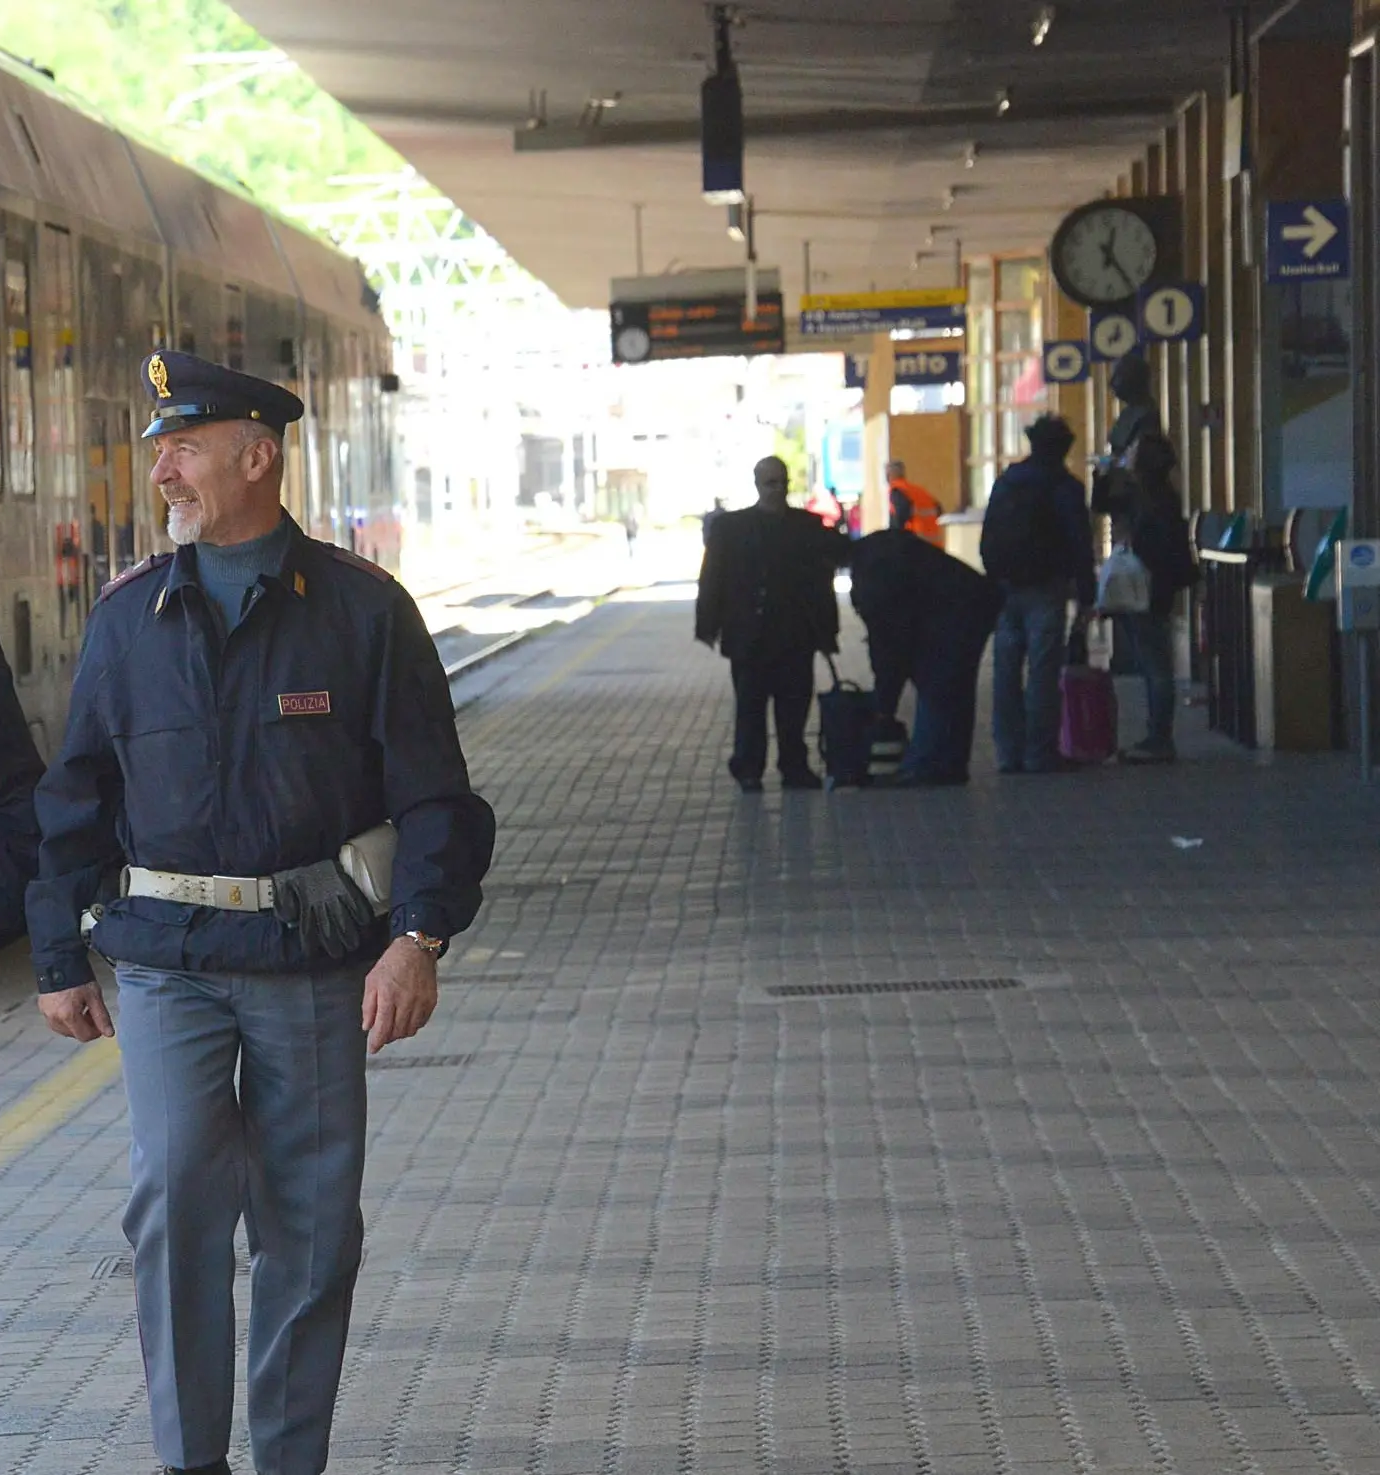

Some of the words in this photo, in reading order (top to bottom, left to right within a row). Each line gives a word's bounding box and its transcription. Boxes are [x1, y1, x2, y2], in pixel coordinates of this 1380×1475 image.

[1162, 296, 1176, 325] 1
[852, 353, 948, 377] Tnto
[282, 698, 325, 710] POLIZIA
